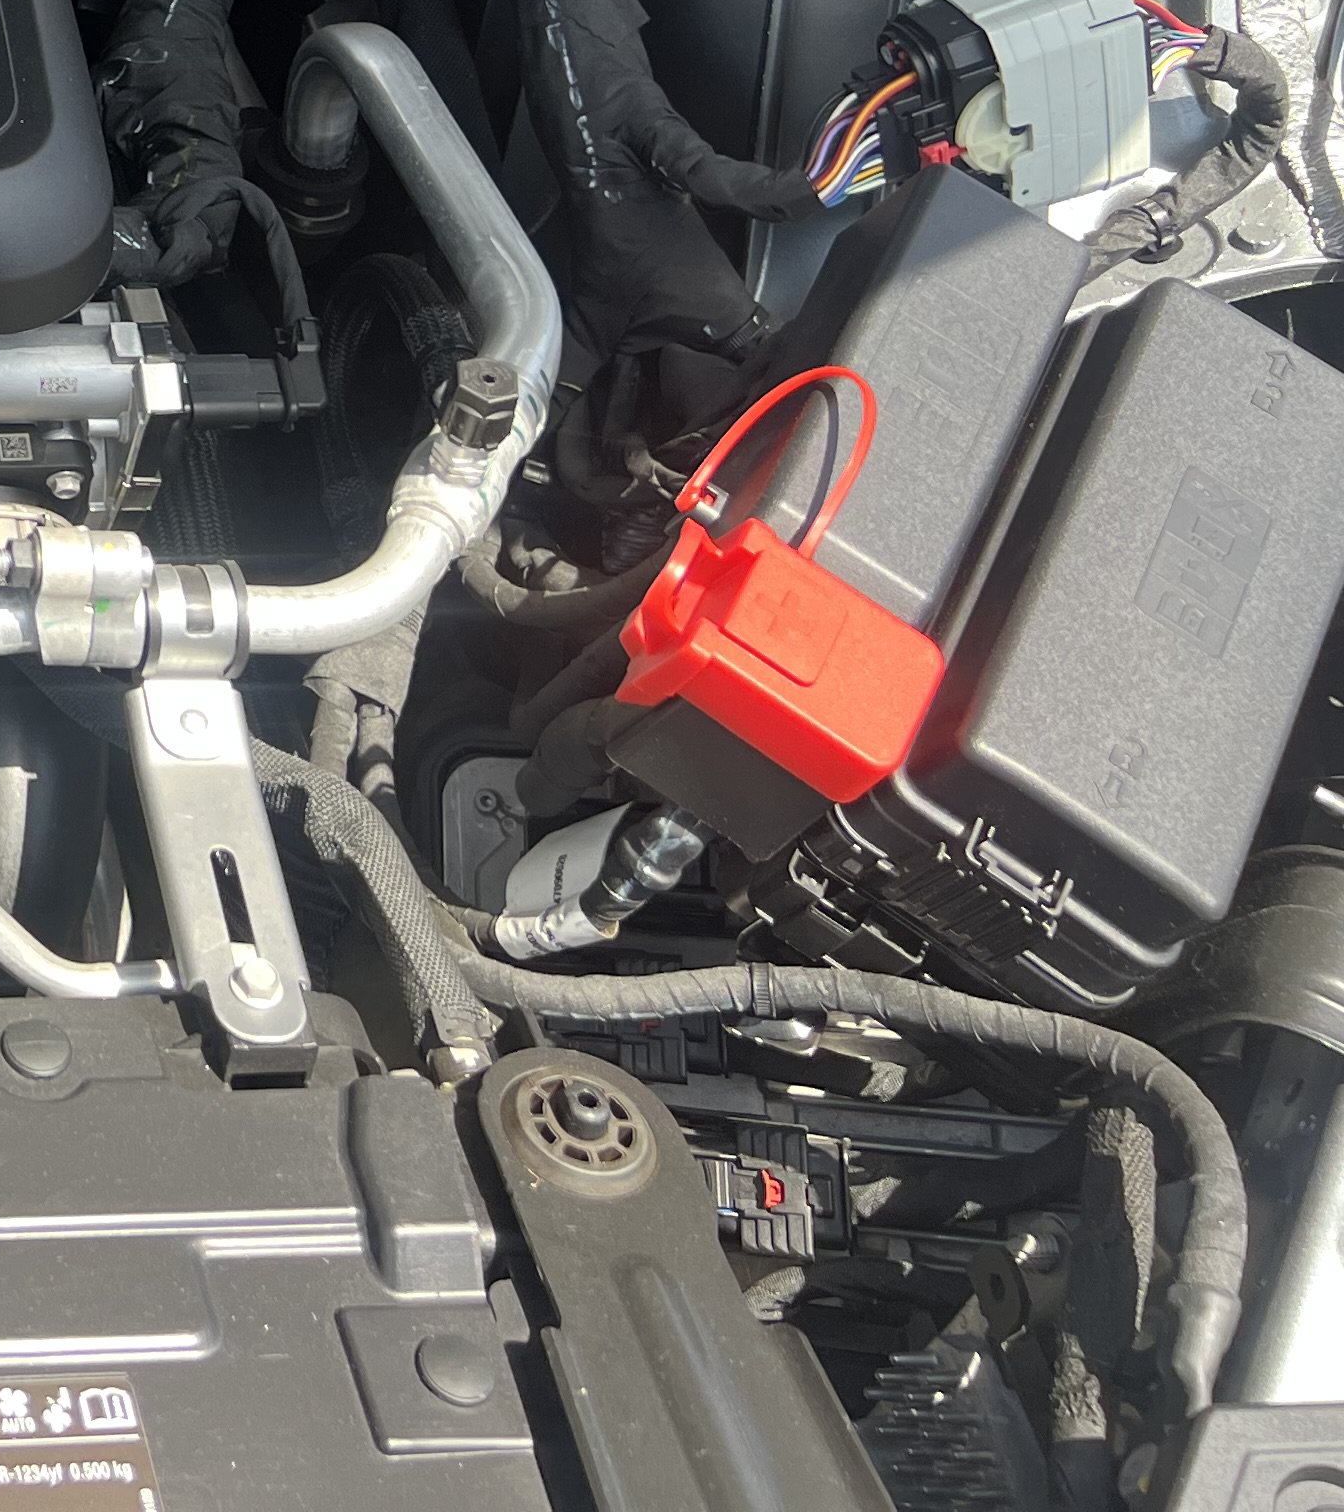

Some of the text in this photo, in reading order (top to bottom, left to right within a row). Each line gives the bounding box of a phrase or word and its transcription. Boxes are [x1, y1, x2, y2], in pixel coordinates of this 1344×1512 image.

[0, 1416, 36, 1433] AUTO
[69, 1460, 111, 1482] 0.500
[112, 1459, 134, 1484] kg
